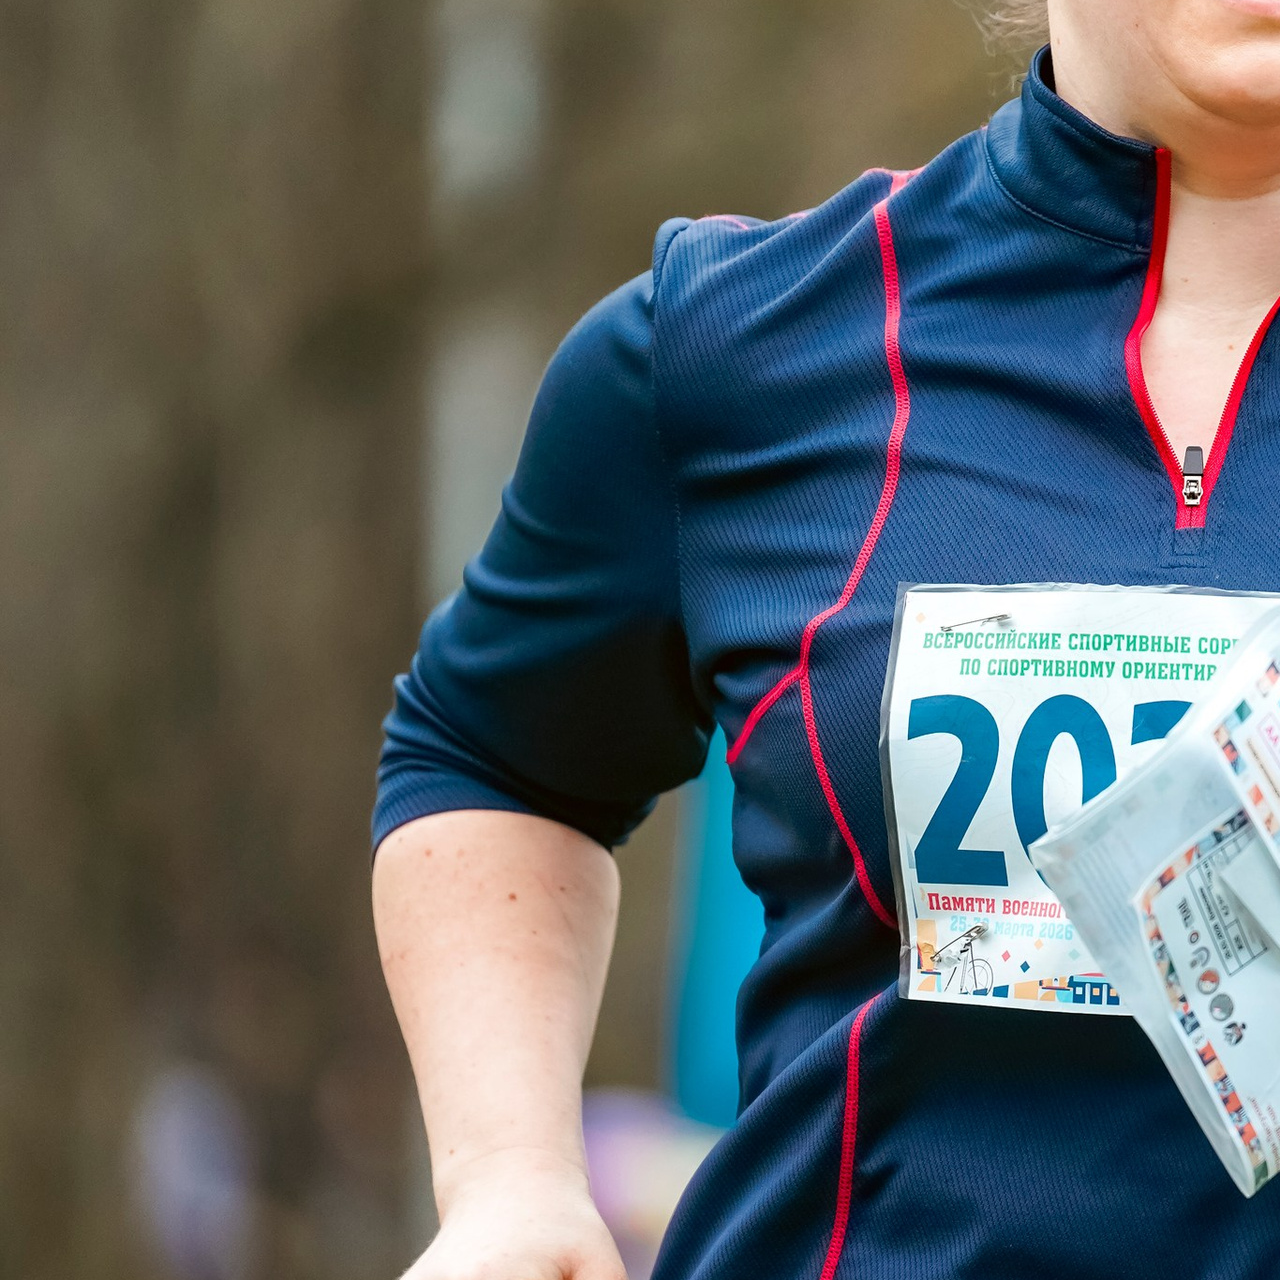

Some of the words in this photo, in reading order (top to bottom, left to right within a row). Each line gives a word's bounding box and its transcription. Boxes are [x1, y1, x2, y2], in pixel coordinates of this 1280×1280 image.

[922, 629, 1061, 651] ВСЕРОССИЙСКИЕ
[1068, 632, 1192, 654] СПОРТИВНЫЕ
[959, 658, 981, 676] ПО
[987, 658, 1116, 679] СПОРТИВНОМУ
[927, 892, 996, 914] Памяти
[993, 921, 1034, 940] марта
[1039, 922, 1074, 941] 2026
